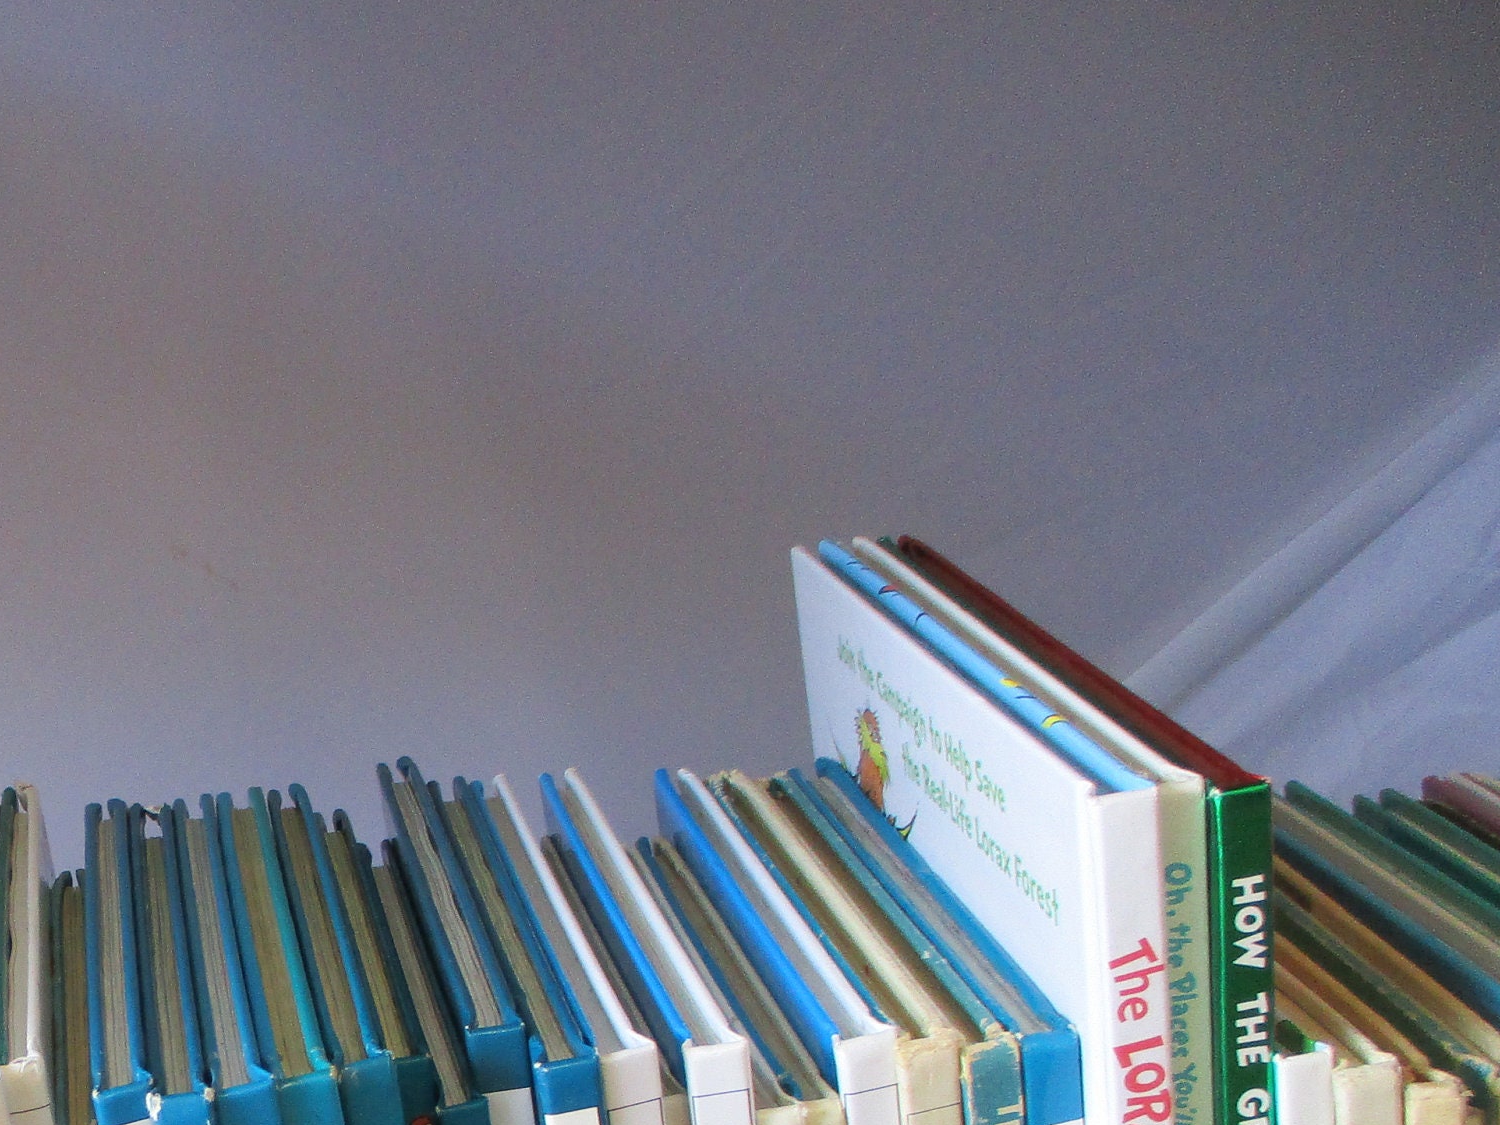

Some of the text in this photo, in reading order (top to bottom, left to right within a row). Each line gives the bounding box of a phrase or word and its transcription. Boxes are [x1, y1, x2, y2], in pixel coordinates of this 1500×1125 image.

[975, 760, 1006, 813] Save
[976, 817, 1059, 926] Lorax Forest
[1231, 873, 1270, 969] HOW
[1108, 937, 1166, 1024] The
[1235, 991, 1271, 1068] THE
